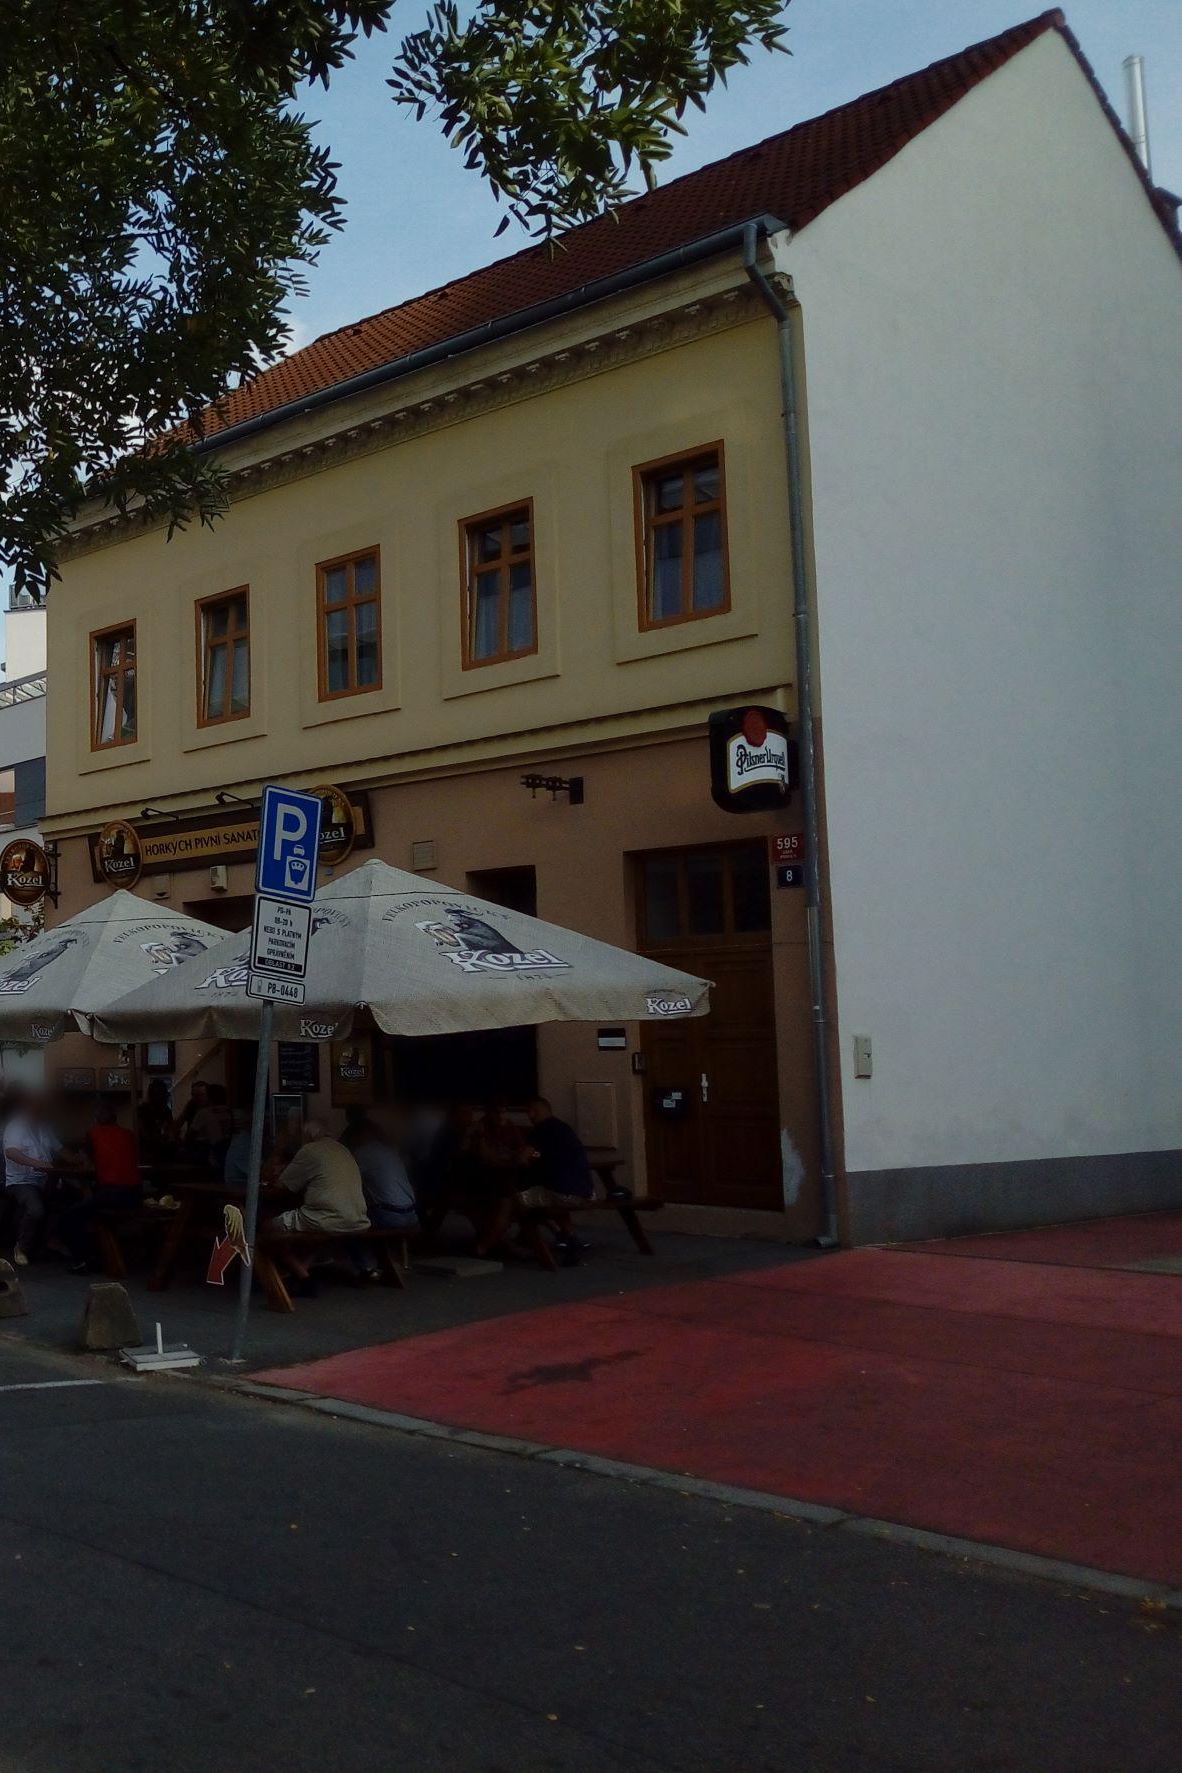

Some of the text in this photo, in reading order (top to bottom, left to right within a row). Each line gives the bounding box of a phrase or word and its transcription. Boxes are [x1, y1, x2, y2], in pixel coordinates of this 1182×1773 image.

[736, 744, 767, 775] Pilsner
[273, 803, 308, 861] P
[318, 827, 347, 845] ozel
[145, 838, 193, 856] HORKÝCH
[777, 836, 799, 850] 595
[104, 857, 136, 873] Kozel
[6, 873, 46, 887] Kozel
[786, 870, 793, 882] 8
[438, 949, 574, 973] Kozel
[645, 997, 693, 1016] Kozel
